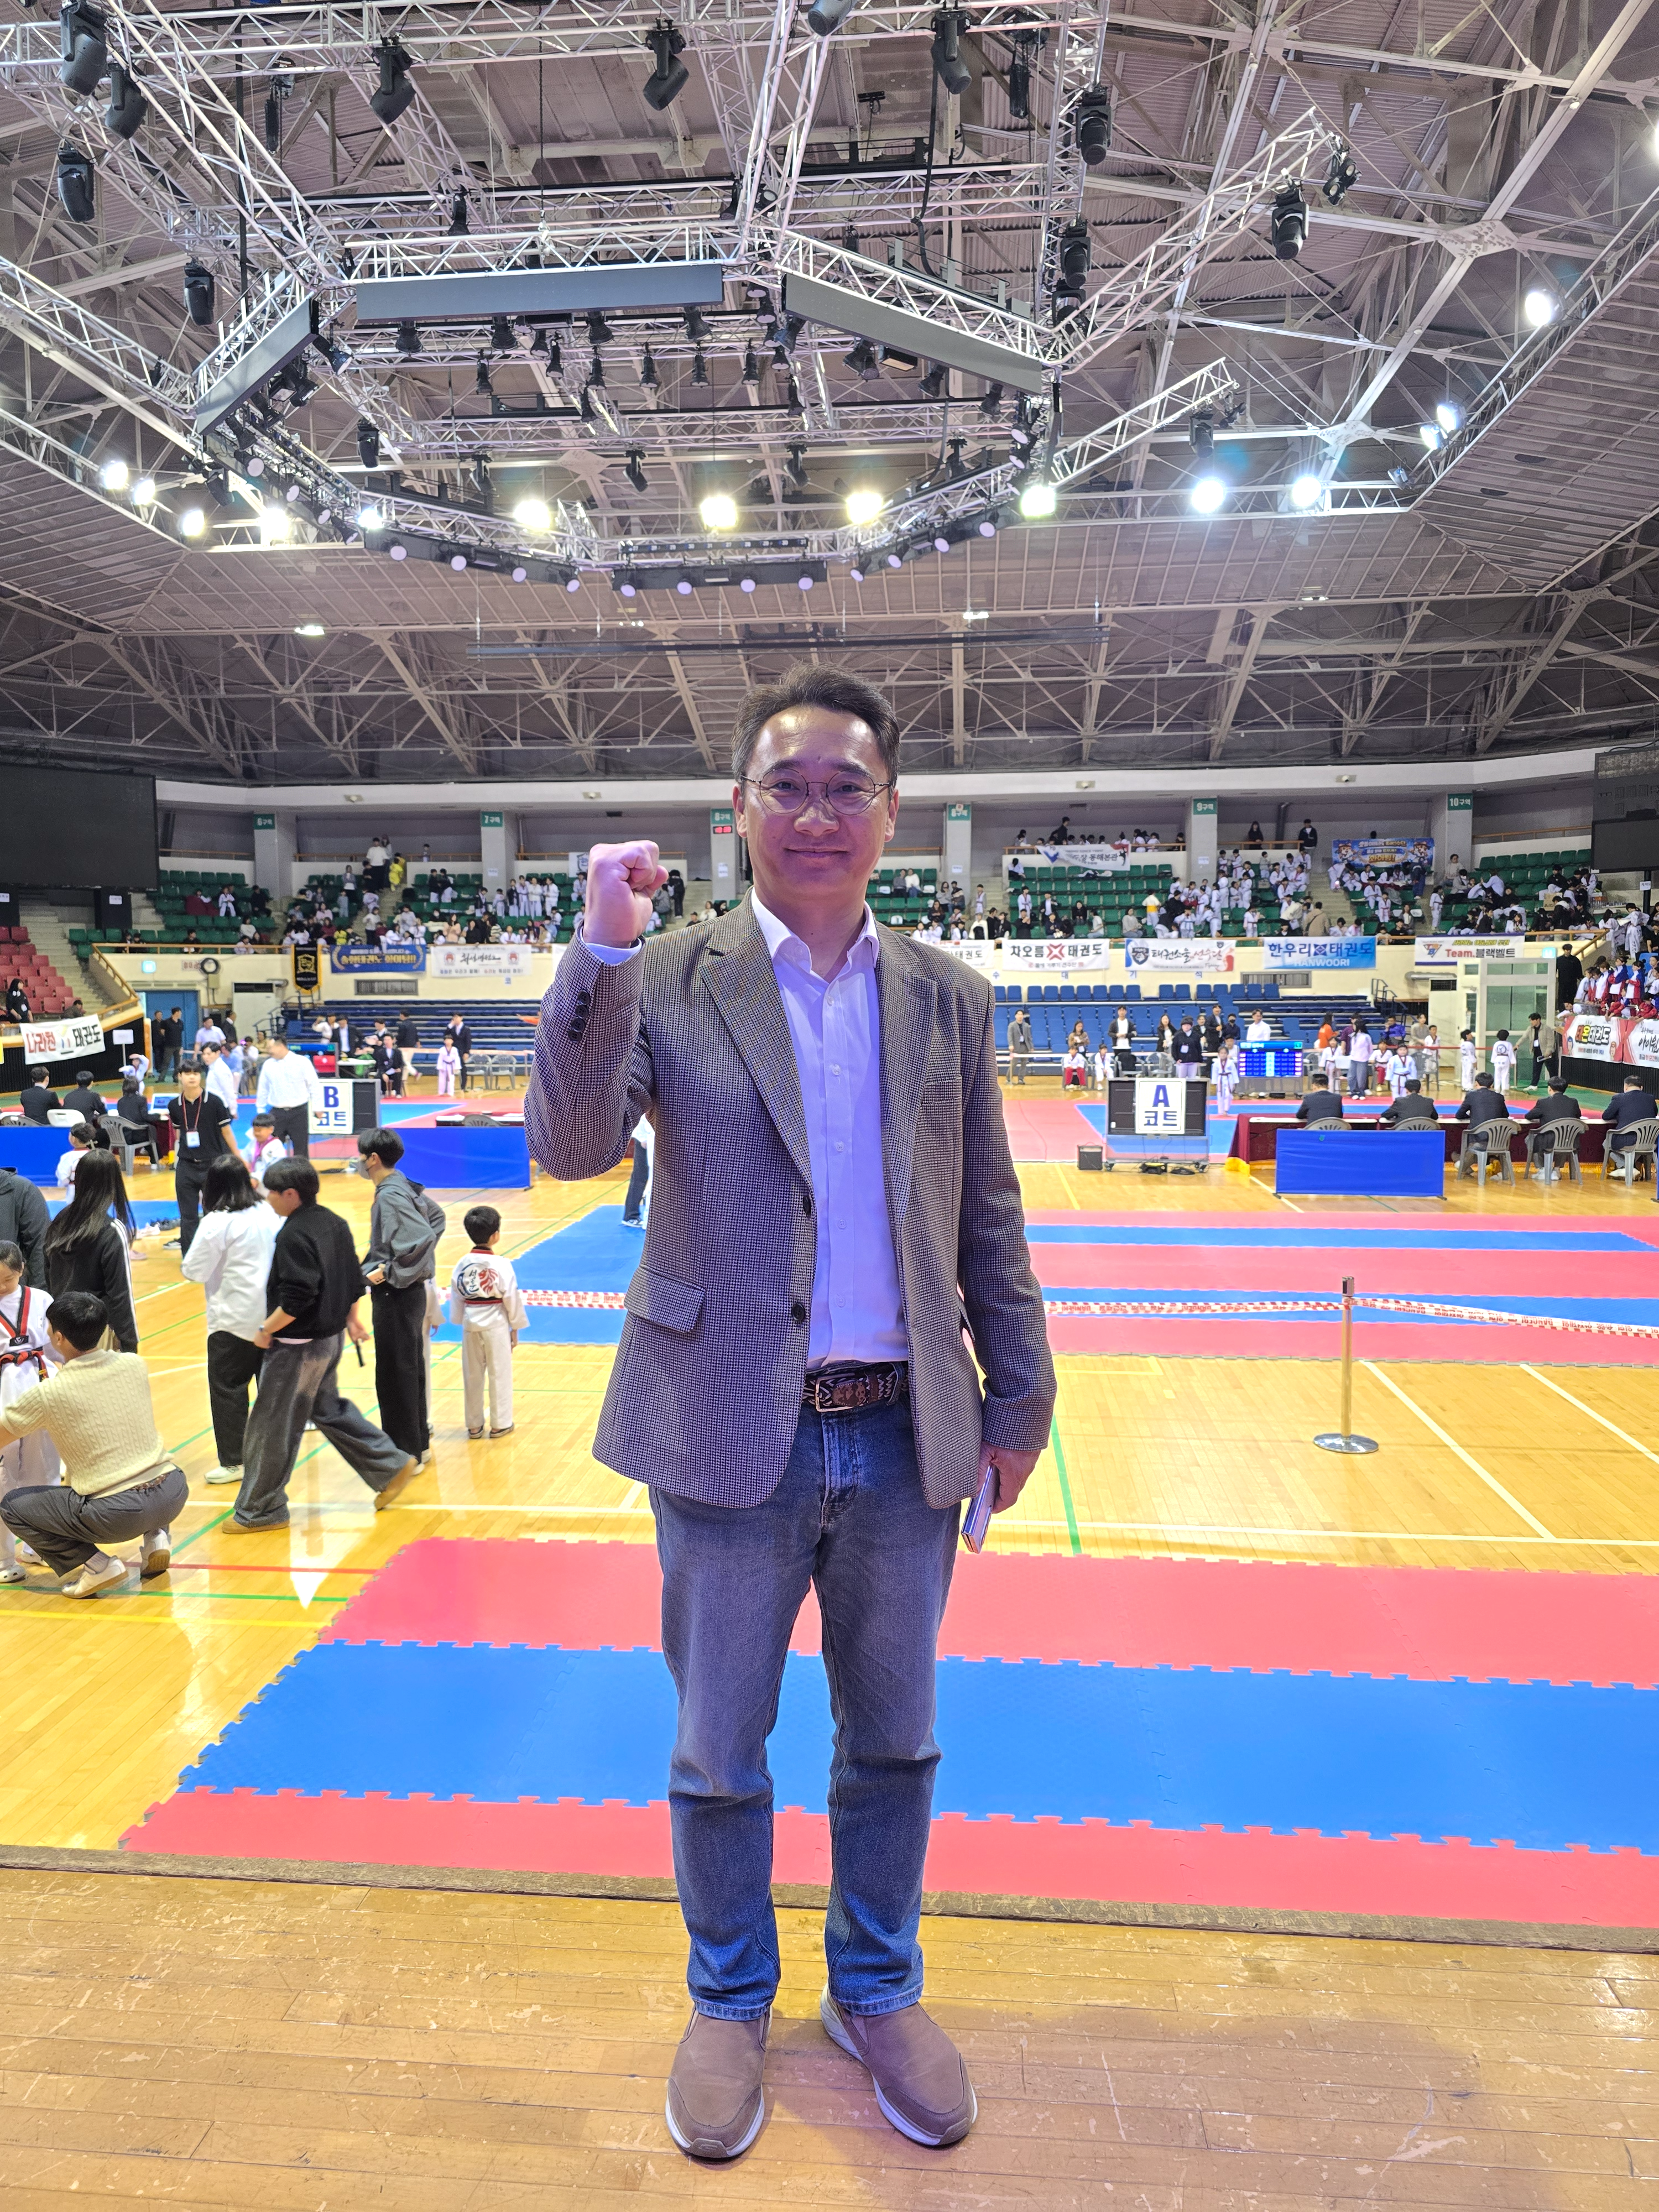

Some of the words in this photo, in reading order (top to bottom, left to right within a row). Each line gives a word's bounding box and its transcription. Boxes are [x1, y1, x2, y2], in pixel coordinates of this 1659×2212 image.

[1196, 802, 1214, 811] 9구역
[1449, 797, 1471, 806] 10구역
[484, 815, 500, 823] 7구역
[1010, 945, 1044, 958] 차오름
[1068, 943, 1102, 957] 태권도
[1269, 943, 1311, 957] 한우리
[1329, 942, 1373, 957] 태권도
[1445, 948, 1515, 958] Team.블랙벨트
[1295, 958, 1350, 967] HANWOORI
[72, 1024, 101, 1047] 태권도
[323, 1086, 340, 1108] B
[1152, 1084, 1170, 1108] A
[316, 1111, 347, 1126] 코트
[1144, 1110, 1177, 1126] 코트
